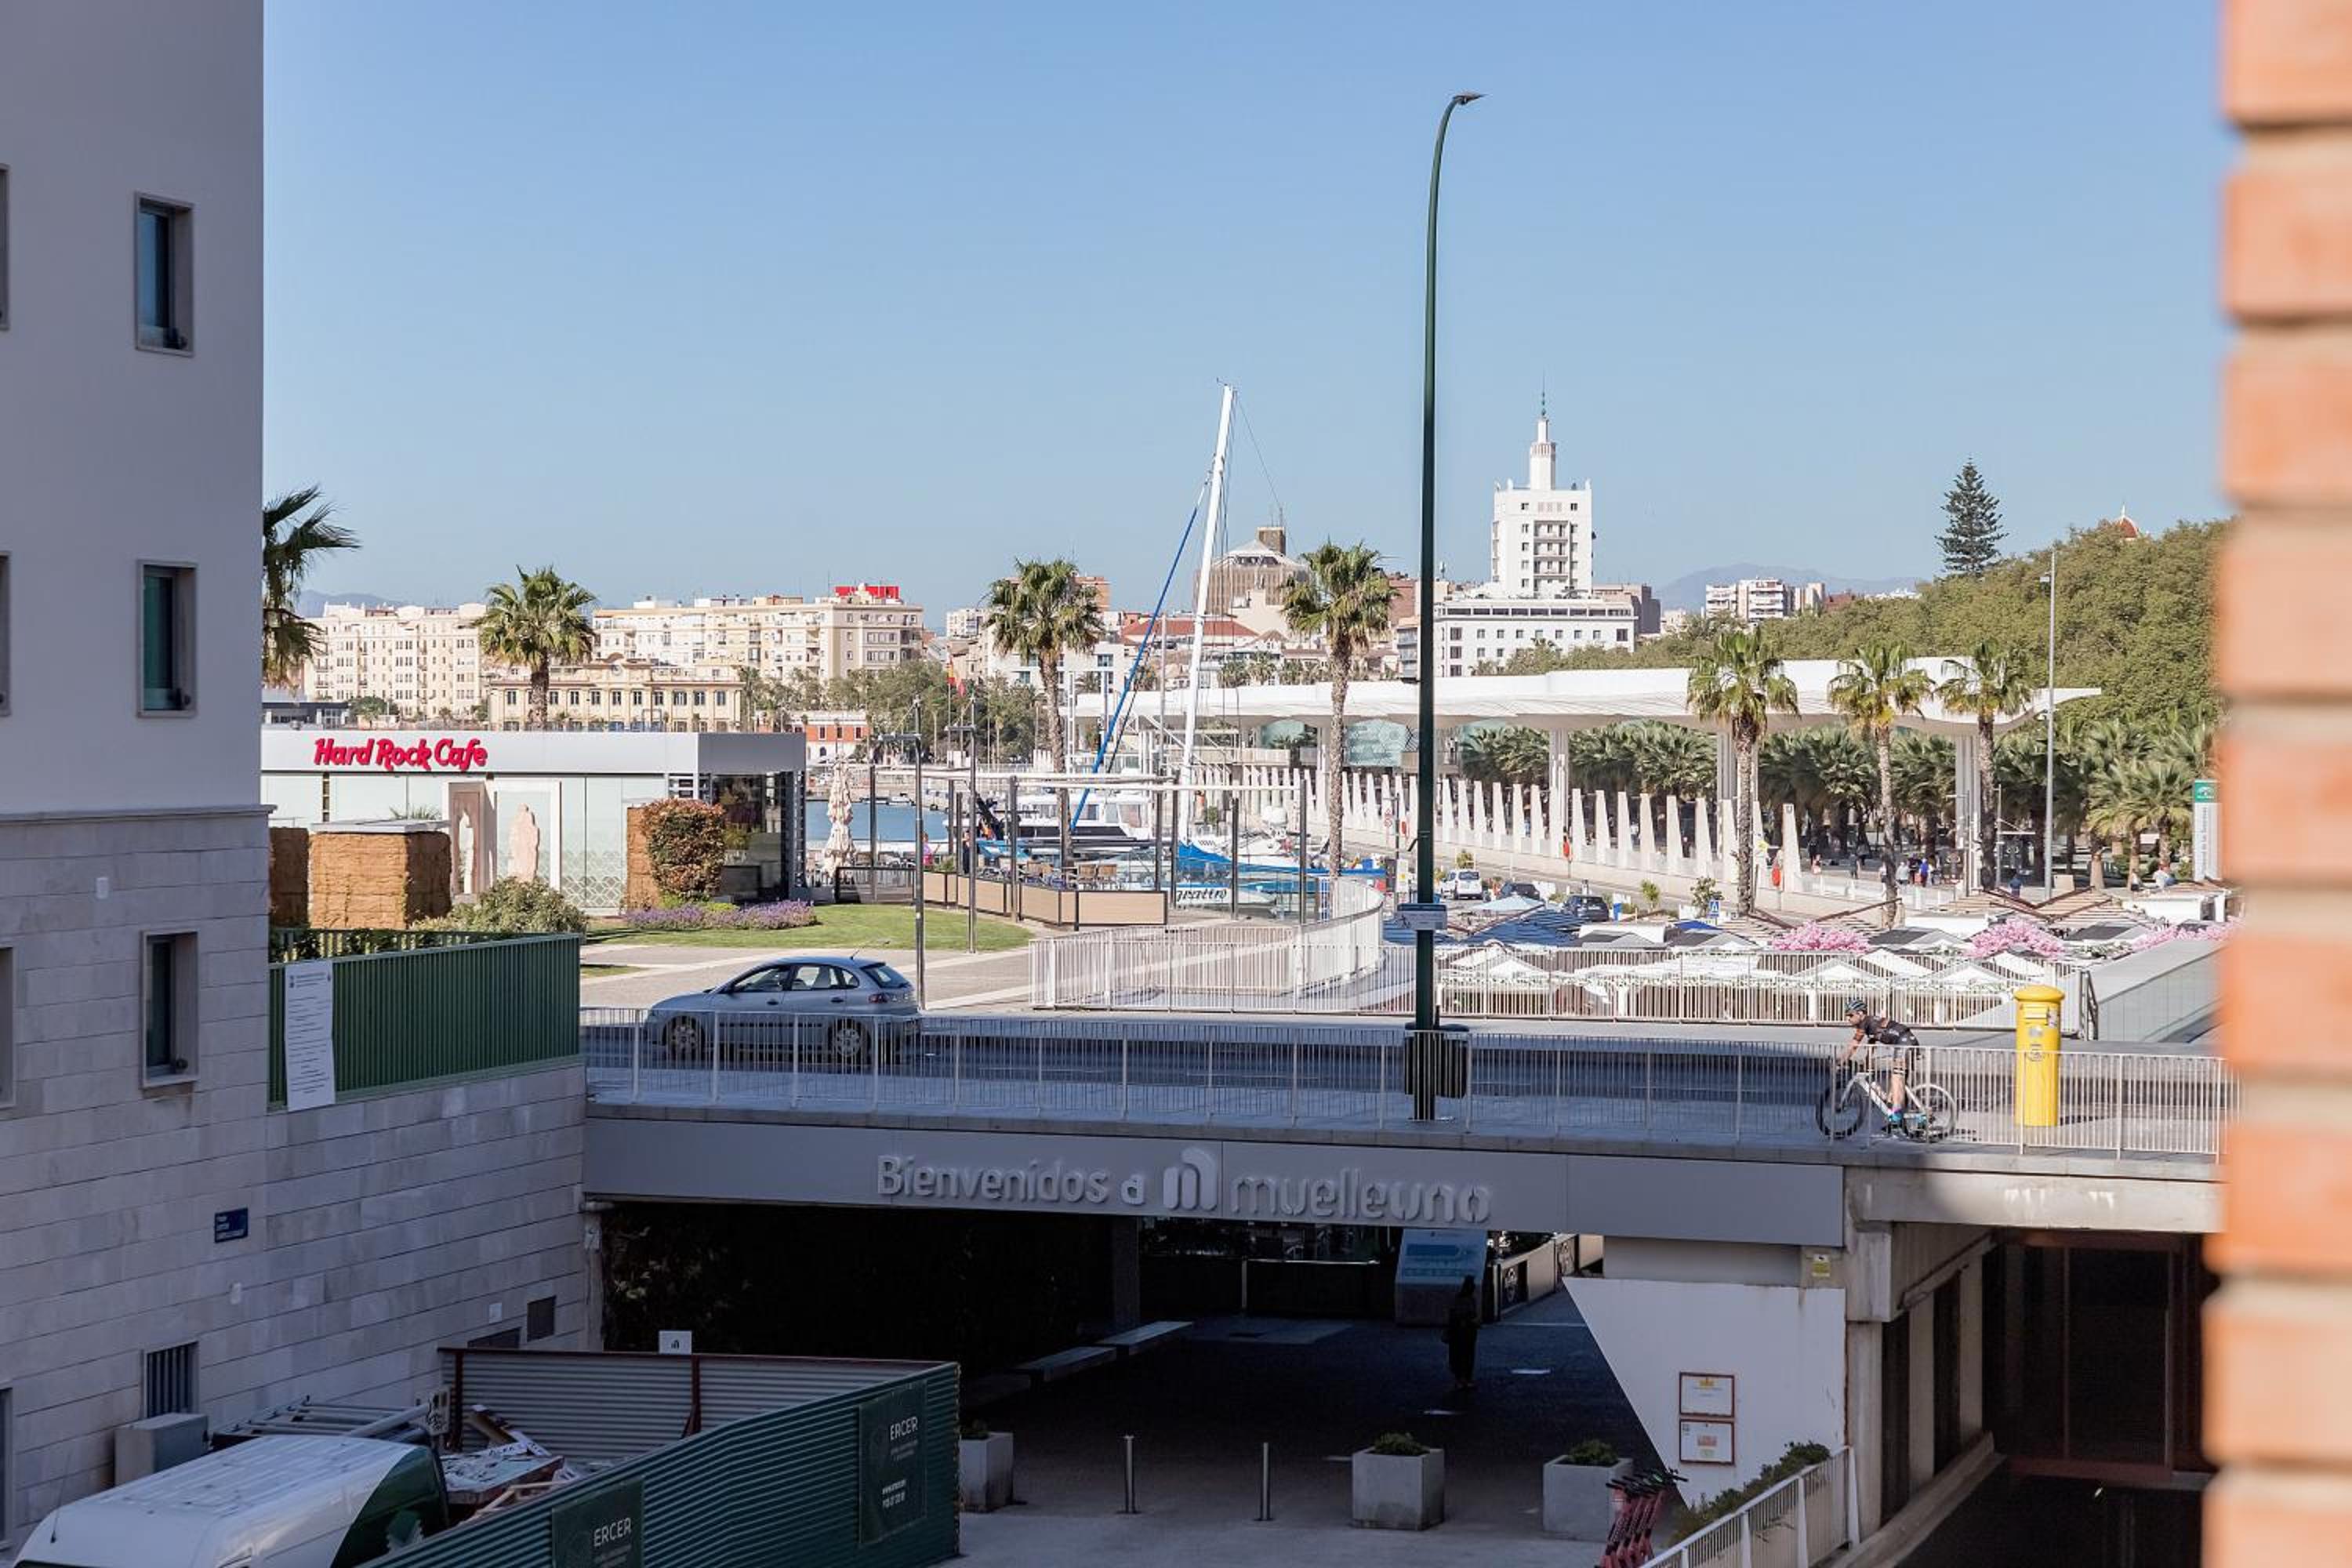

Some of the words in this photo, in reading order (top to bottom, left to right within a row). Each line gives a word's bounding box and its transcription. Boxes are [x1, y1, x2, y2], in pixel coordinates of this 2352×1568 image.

[314, 737, 375, 767] Hard
[376, 738, 433, 771] Rock
[434, 737, 488, 772] Cafe
[877, 1154, 1109, 1203] Bienvenidos
[1120, 1174, 1146, 1206] a
[1230, 1166, 1490, 1223] muelleuno
[890, 1416, 919, 1441] ERCER
[593, 1517, 632, 1548] ERCER
